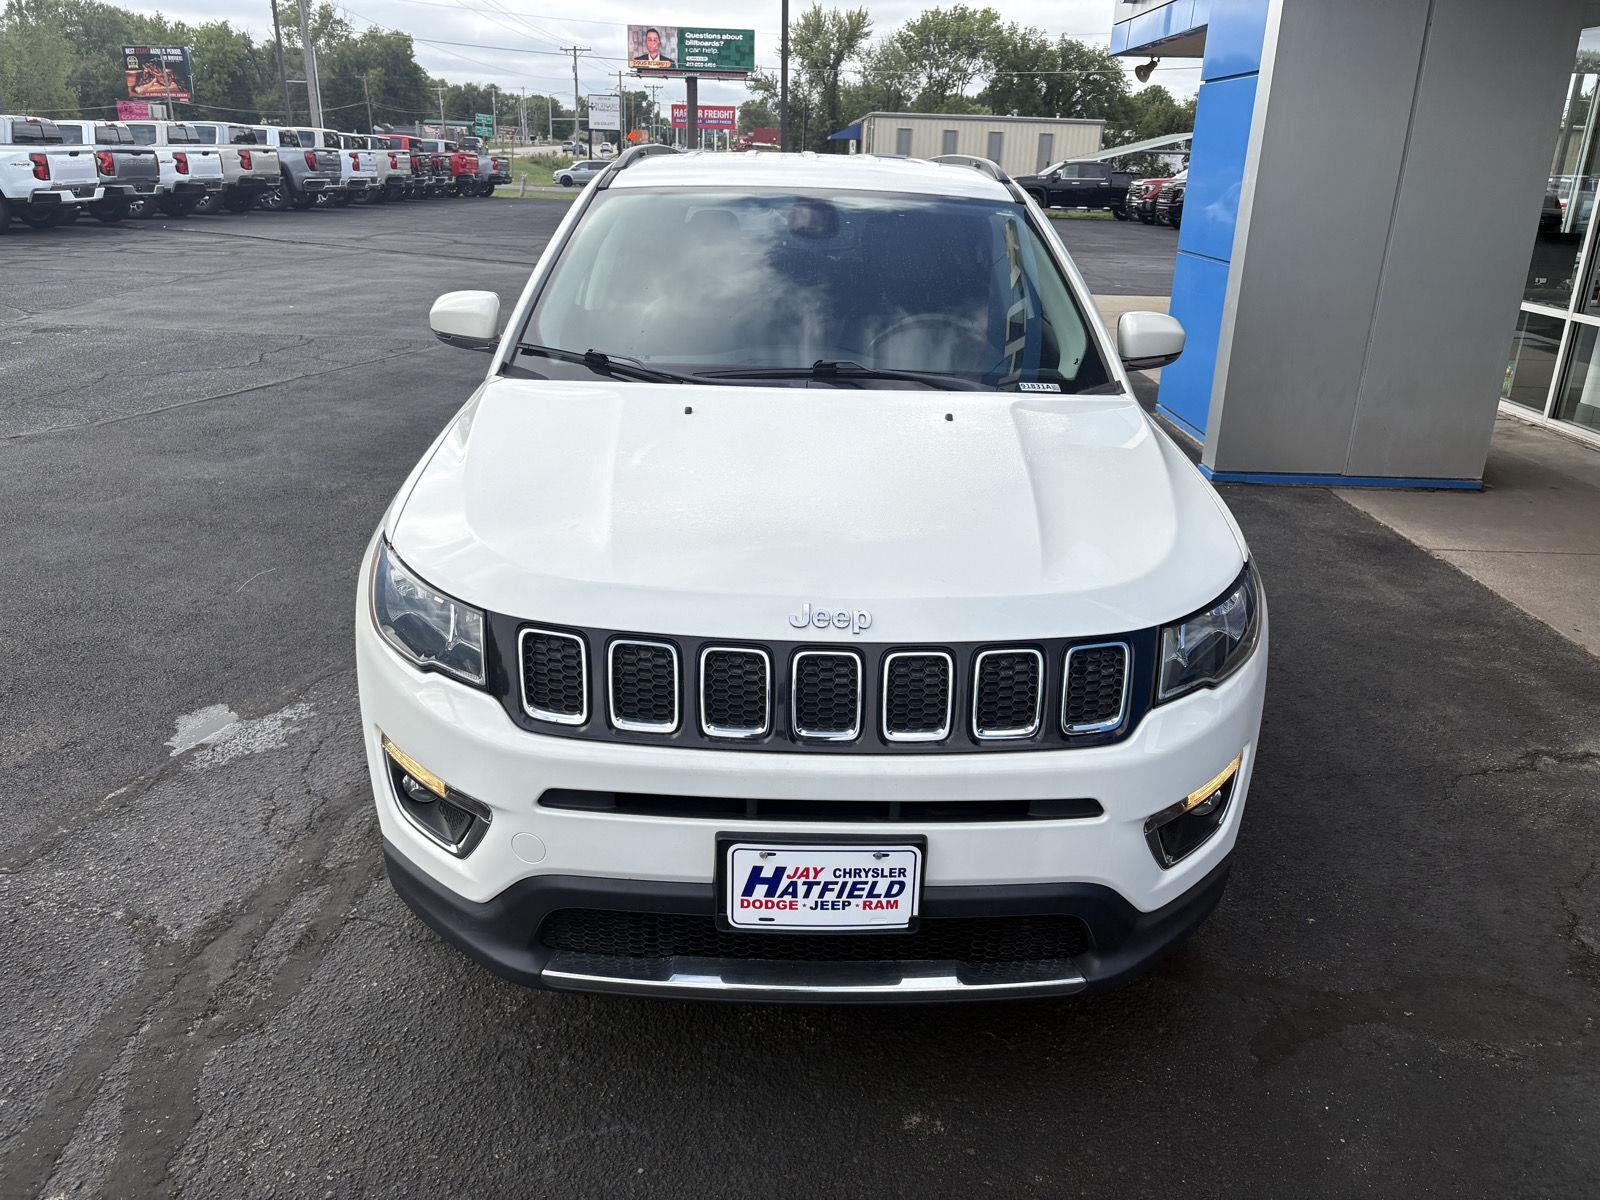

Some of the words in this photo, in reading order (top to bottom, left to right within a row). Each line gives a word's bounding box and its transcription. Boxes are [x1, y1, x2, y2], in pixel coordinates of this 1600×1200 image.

[685, 32, 721, 40] Questions
[721, 33, 743, 41] about
[702, 47, 720, 55] help.
[704, 109, 734, 119] FREIGHT
[788, 603, 873, 634] Jeep
[786, 866, 825, 880] JAY
[832, 867, 907, 879] CHRYSLER
[740, 865, 907, 899] HATFIELD
[740, 898, 799, 911] DODGE
[809, 899, 851, 911] JEEP
[862, 899, 899, 910] RAM
